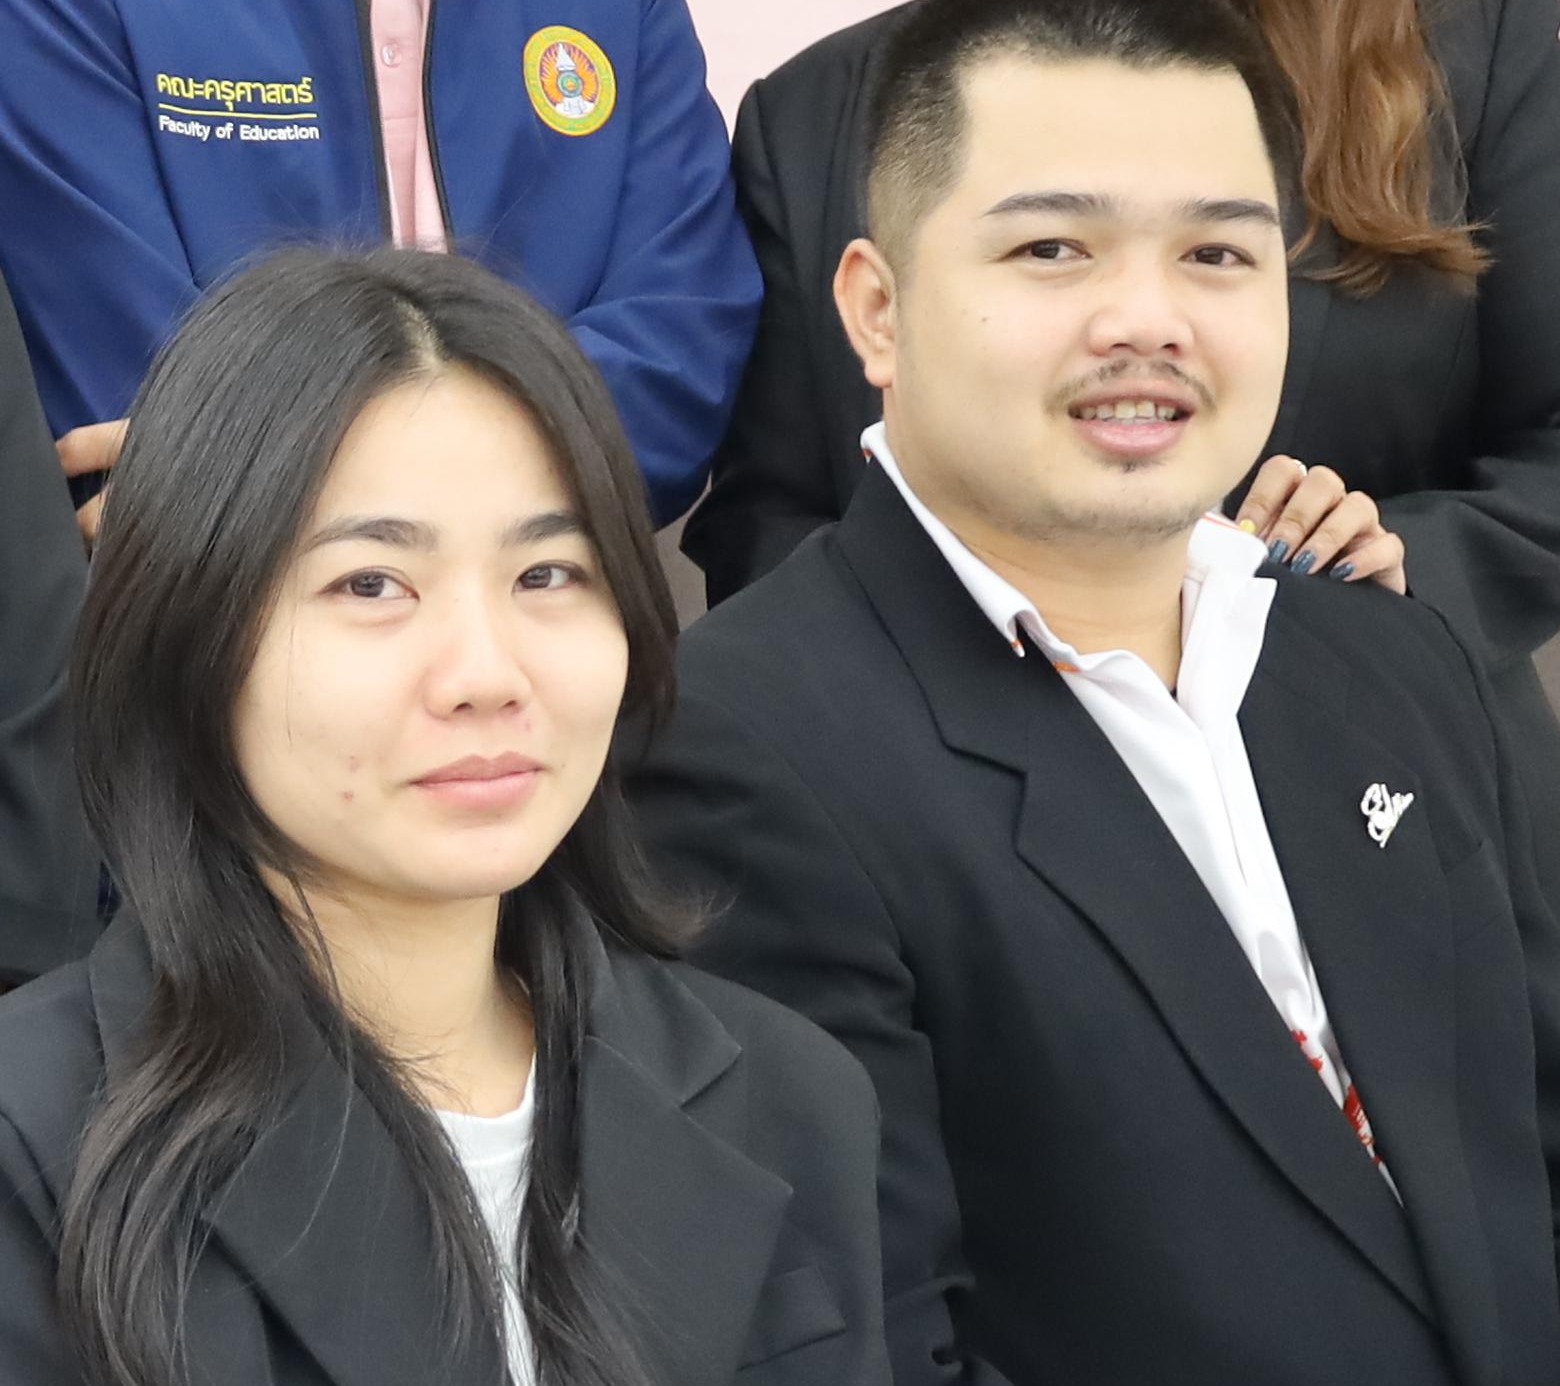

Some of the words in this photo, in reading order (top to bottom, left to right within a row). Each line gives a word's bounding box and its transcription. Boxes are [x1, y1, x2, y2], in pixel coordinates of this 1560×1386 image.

[156, 73, 314, 112] คณะครุศาสตร์
[158, 114, 211, 142] Faculty
[215, 122, 234, 139] of
[239, 124, 320, 141] Education
